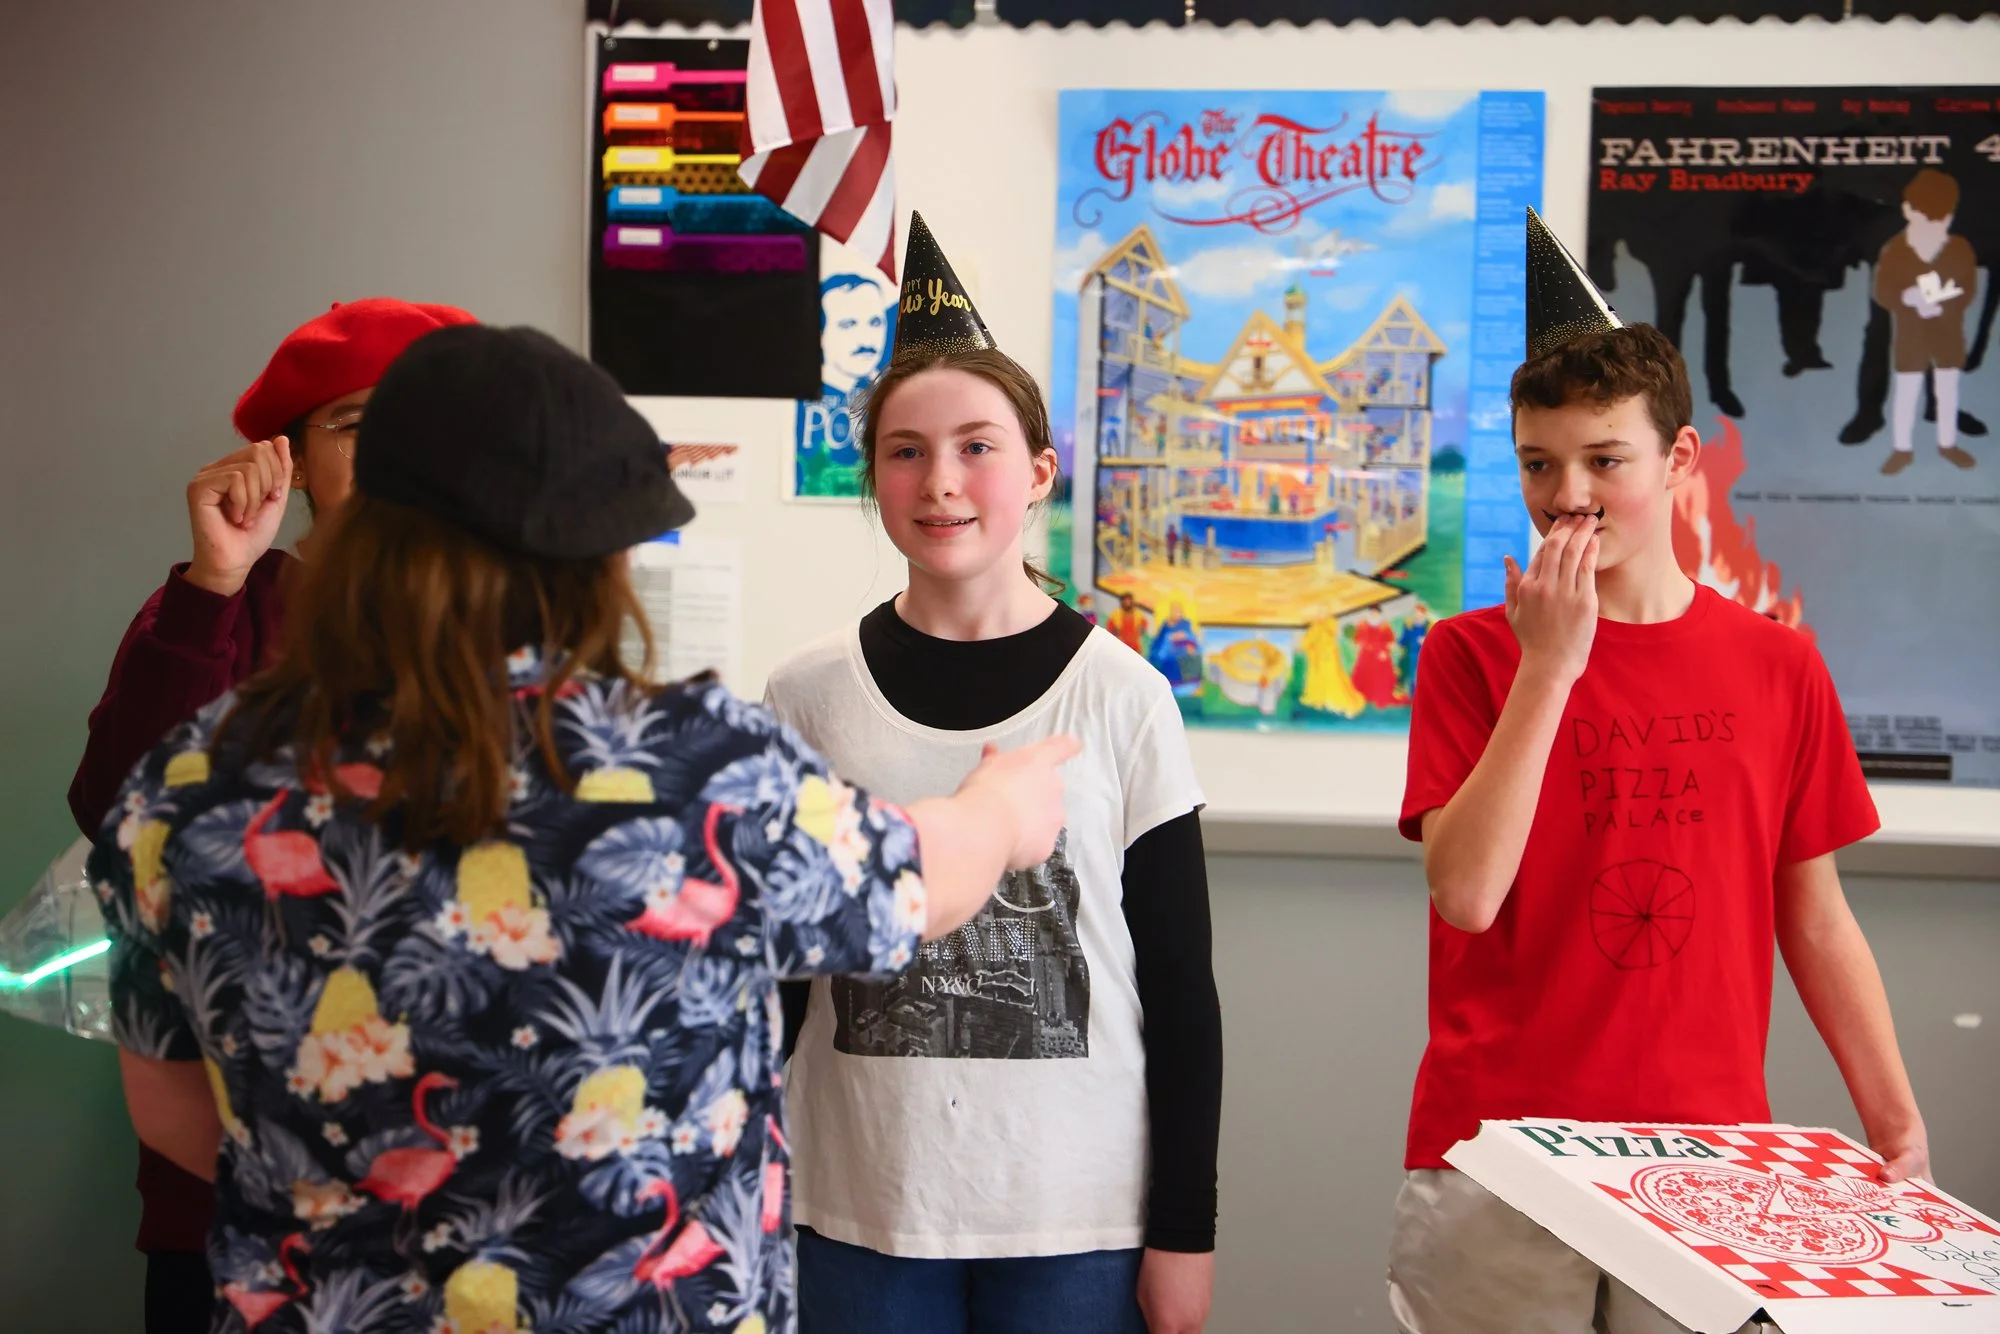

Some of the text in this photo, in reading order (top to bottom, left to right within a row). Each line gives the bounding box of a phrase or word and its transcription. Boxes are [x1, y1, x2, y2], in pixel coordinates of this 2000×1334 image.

[1200, 108, 1237, 138] The
[1092, 110, 1444, 205] Globe Theatre
[1600, 136, 1951, 166] FAHRENHEIT
[1600, 168, 1814, 194] Ray Bradbury
[927, 278, 972, 316] Year
[802, 405, 865, 450] PO
[1573, 710, 1736, 758] DAVID'S
[1580, 768, 1700, 802] PIZZA
[920, 976, 982, 996] NY&C
[1508, 1124, 1726, 1159] Pizza
[1910, 1239, 2000, 1261] Bake
